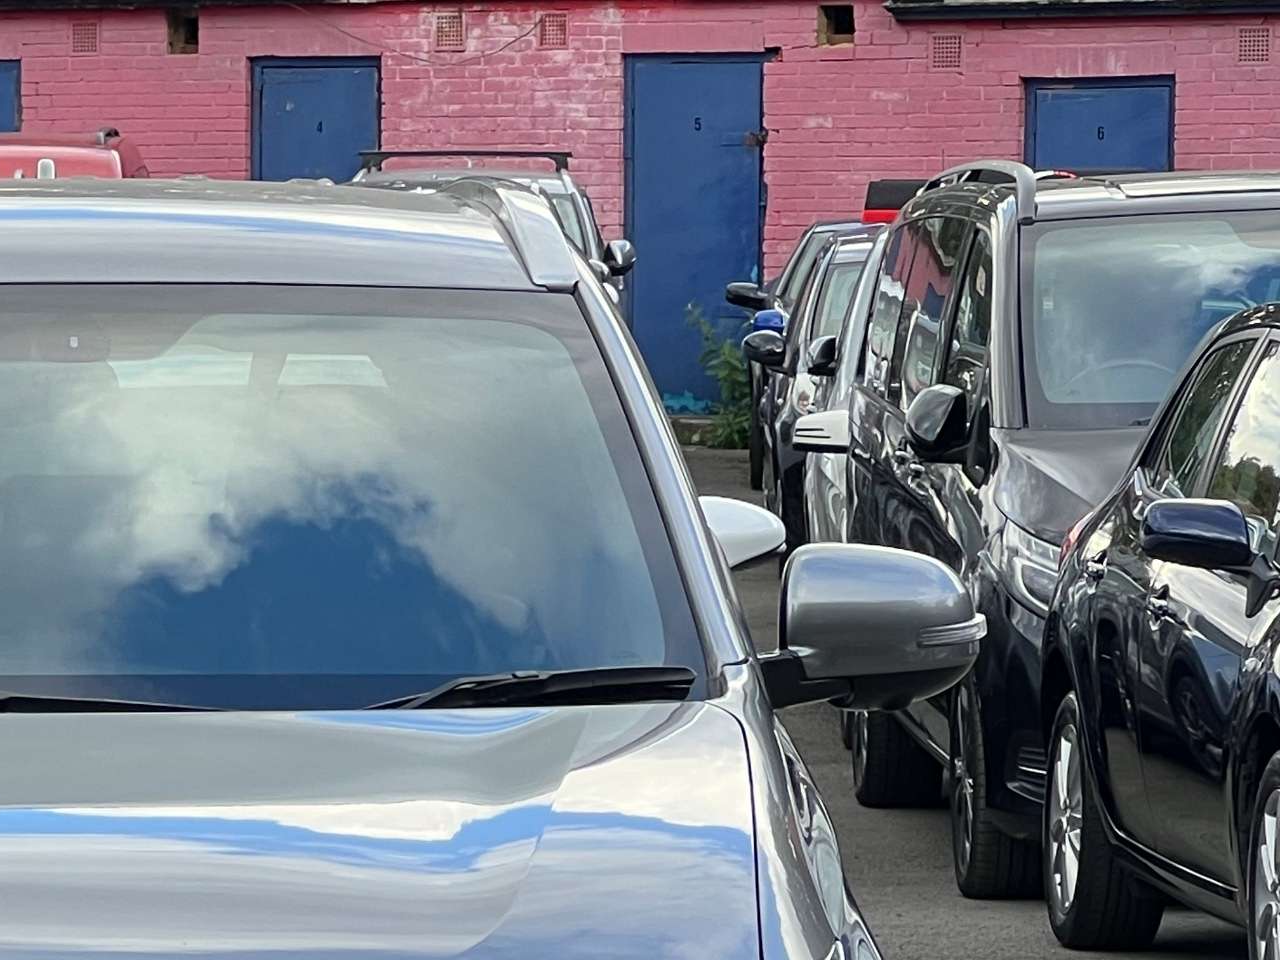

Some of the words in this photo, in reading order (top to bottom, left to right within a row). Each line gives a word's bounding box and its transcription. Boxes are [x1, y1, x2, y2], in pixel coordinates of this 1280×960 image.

[316, 120, 323, 133] 4
[694, 117, 702, 131] 5
[1097, 126, 1105, 141] 6
